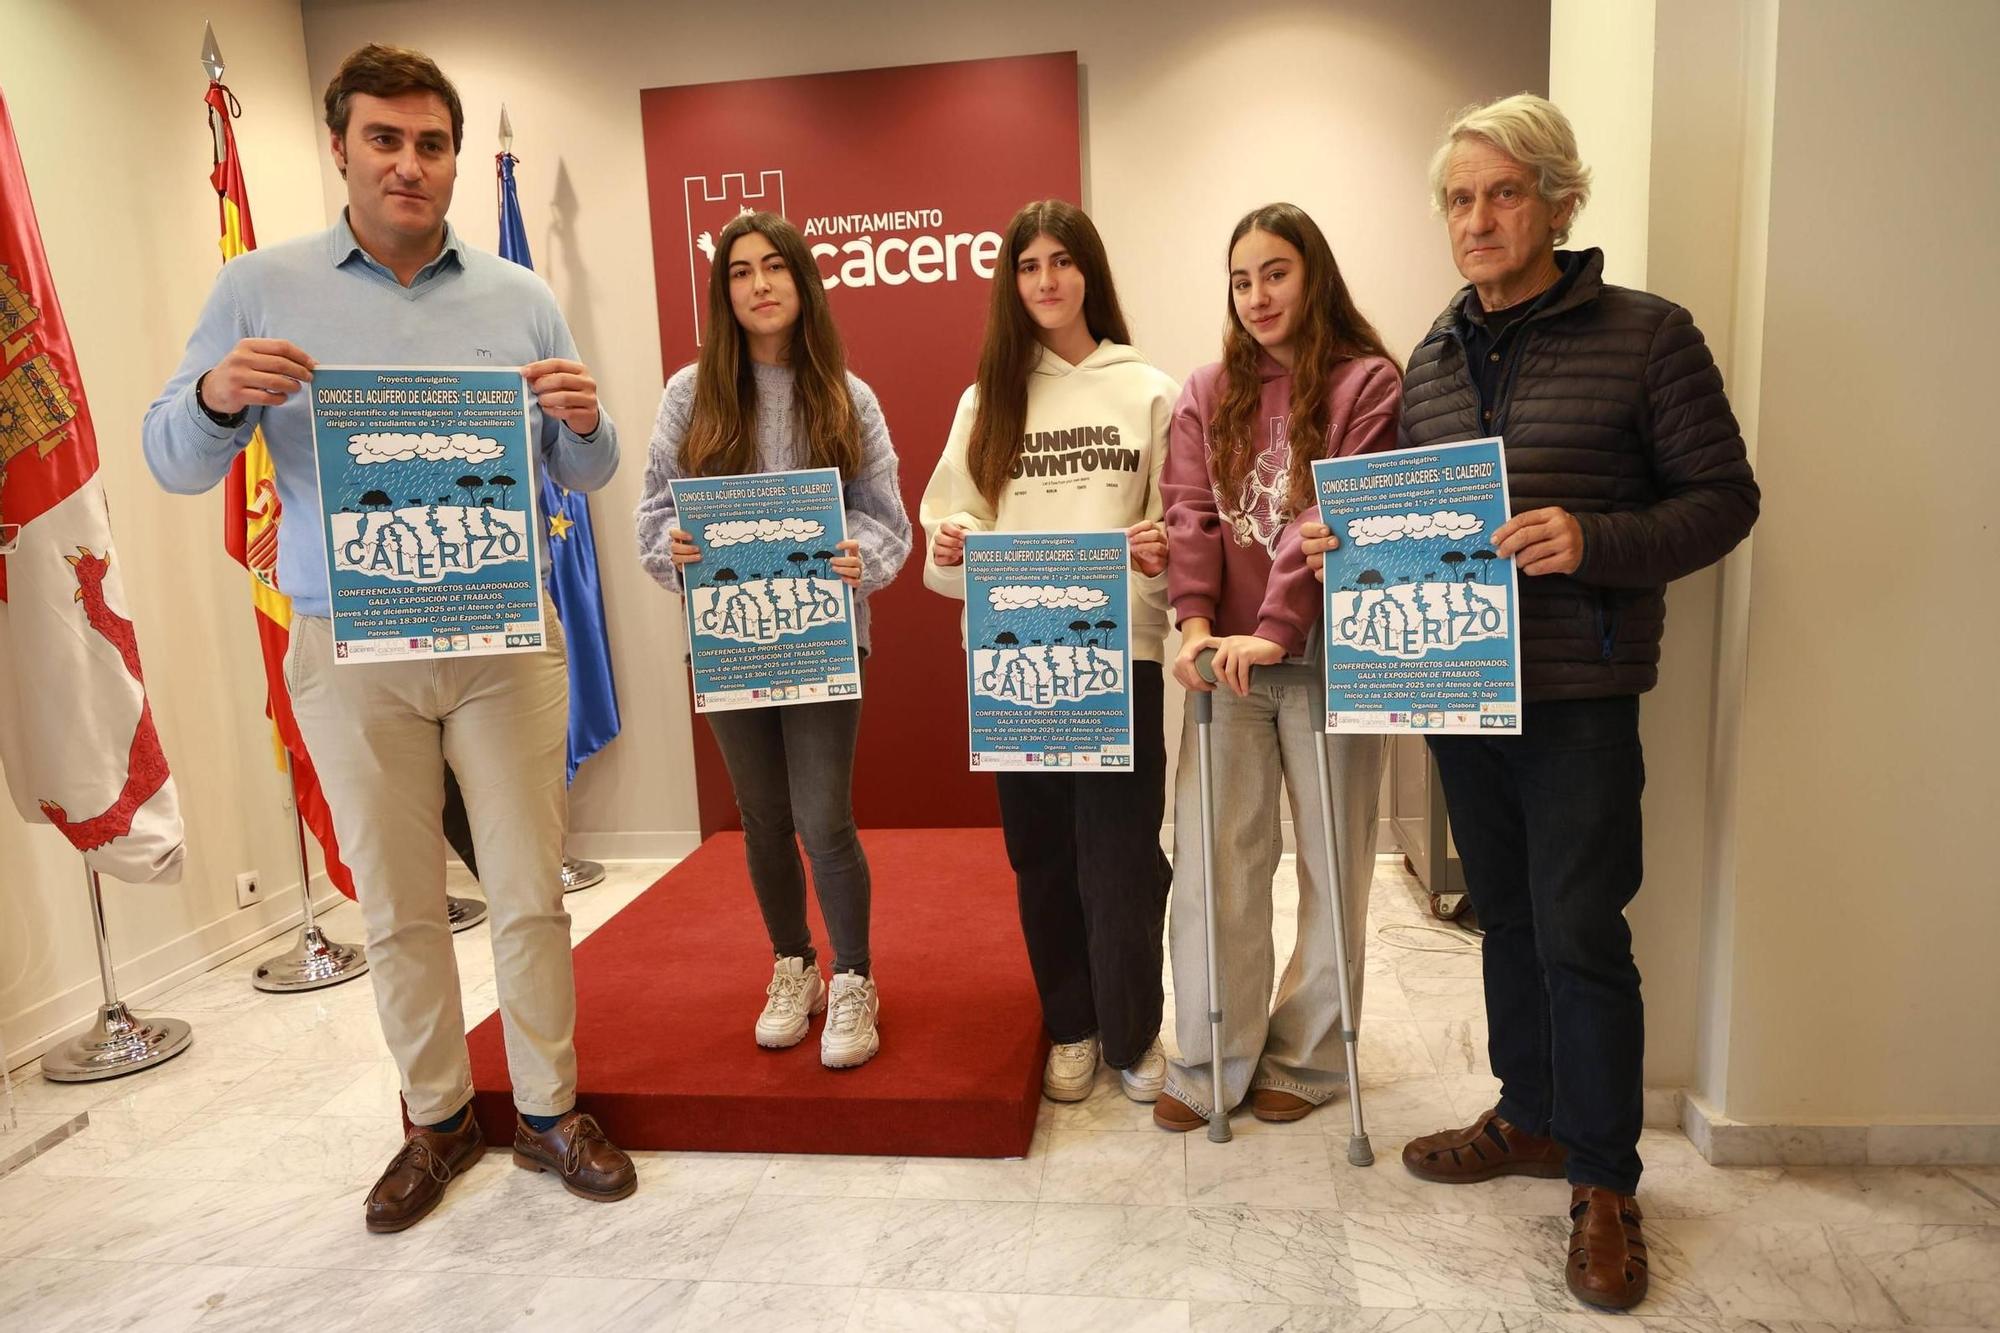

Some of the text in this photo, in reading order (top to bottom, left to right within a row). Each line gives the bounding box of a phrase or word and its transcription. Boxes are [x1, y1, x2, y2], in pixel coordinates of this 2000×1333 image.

[804, 209, 943, 236] AYUNTAMIENTO
[811, 230, 1003, 290] cácere
[377, 375, 413, 384] Proyecto
[318, 389, 353, 404] CONOCE
[355, 390, 365, 403] EL
[366, 386, 407, 404] ACUÍFERO
[408, 390, 419, 403] DE
[421, 387, 460, 404] CÁCERES:
[316, 409, 347, 417] Trabajo
[401, 409, 453, 417] investigación
[326, 420, 358, 428] dirigido
[1008, 448, 1141, 479] OWNTOWN
[1367, 461, 1398, 469] Proyecto
[1322, 479, 1349, 494] CONOCE
[1350, 478, 1358, 491] EL
[1359, 473, 1393, 490] ACUÍFERO
[1394, 473, 1404, 486] DE
[1405, 468, 1440, 485] CÁCERES:
[1346, 495, 1378, 503] científico
[1389, 489, 1435, 499] investigación
[1444, 482, 1501, 493] documentación
[1330, 507, 1354, 515] dirigido
[1363, 503, 1402, 511] estudiantes
[1449, 493, 1494, 503] bachillerato
[345, 532, 520, 578] CALERIZO
[338, 587, 402, 597] CONFERENCIAS
[417, 584, 463, 593] PROYECTOS
[399, 595, 448, 604] EXPOSICIÓN
[383, 607, 422, 615] diciembre
[424, 605, 445, 613] 2025
[1341, 607, 1500, 654] CALERIZO
[1333, 662, 1387, 670] CONFERENCIAS
